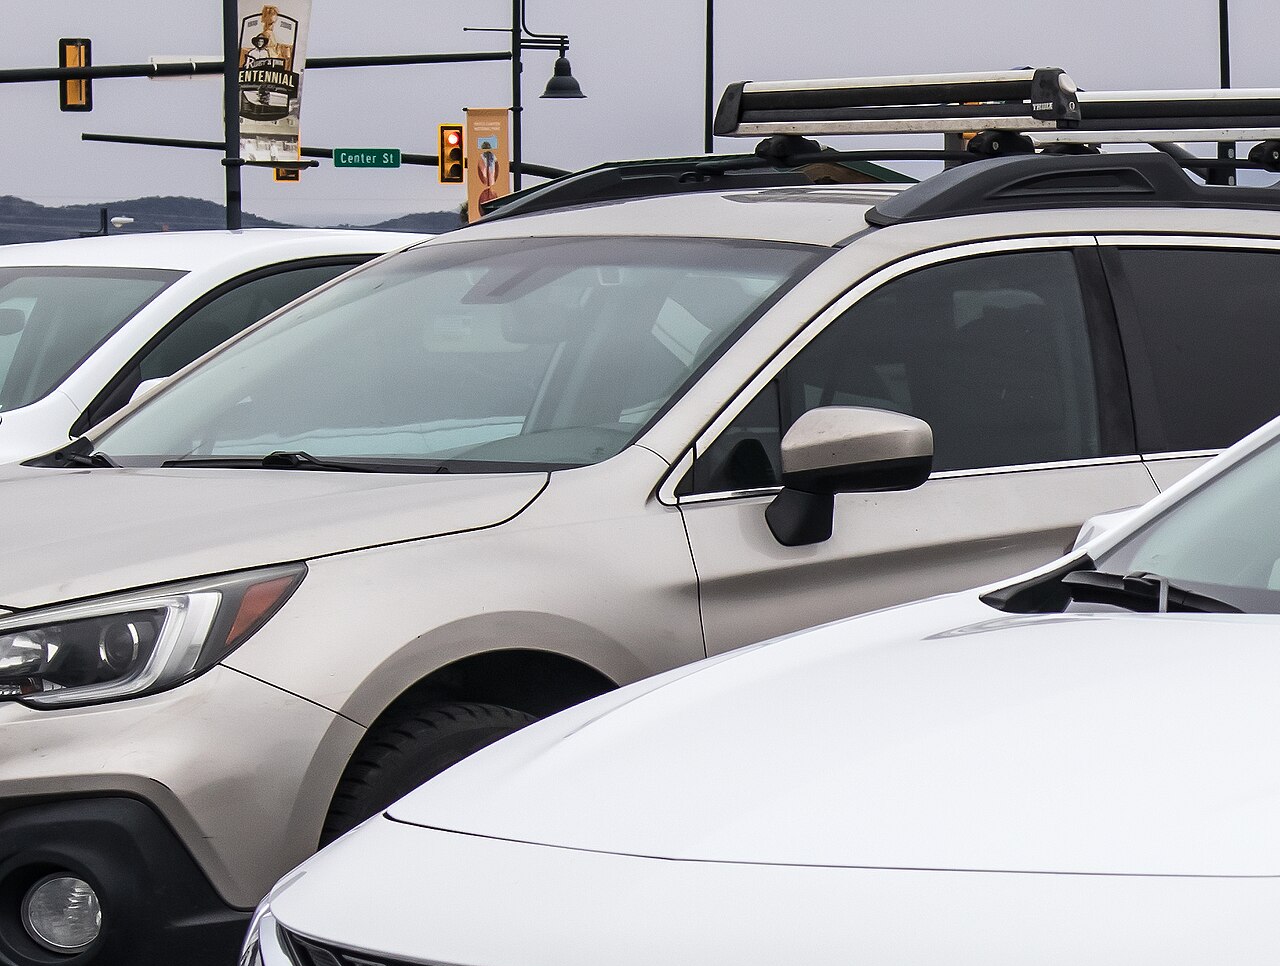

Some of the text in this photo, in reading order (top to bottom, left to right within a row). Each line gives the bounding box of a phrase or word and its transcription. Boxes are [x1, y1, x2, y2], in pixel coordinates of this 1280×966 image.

[238, 70, 295, 88] ENTENNIAL
[1032, 102, 1054, 111] THULE
[340, 152, 394, 164] Center St
